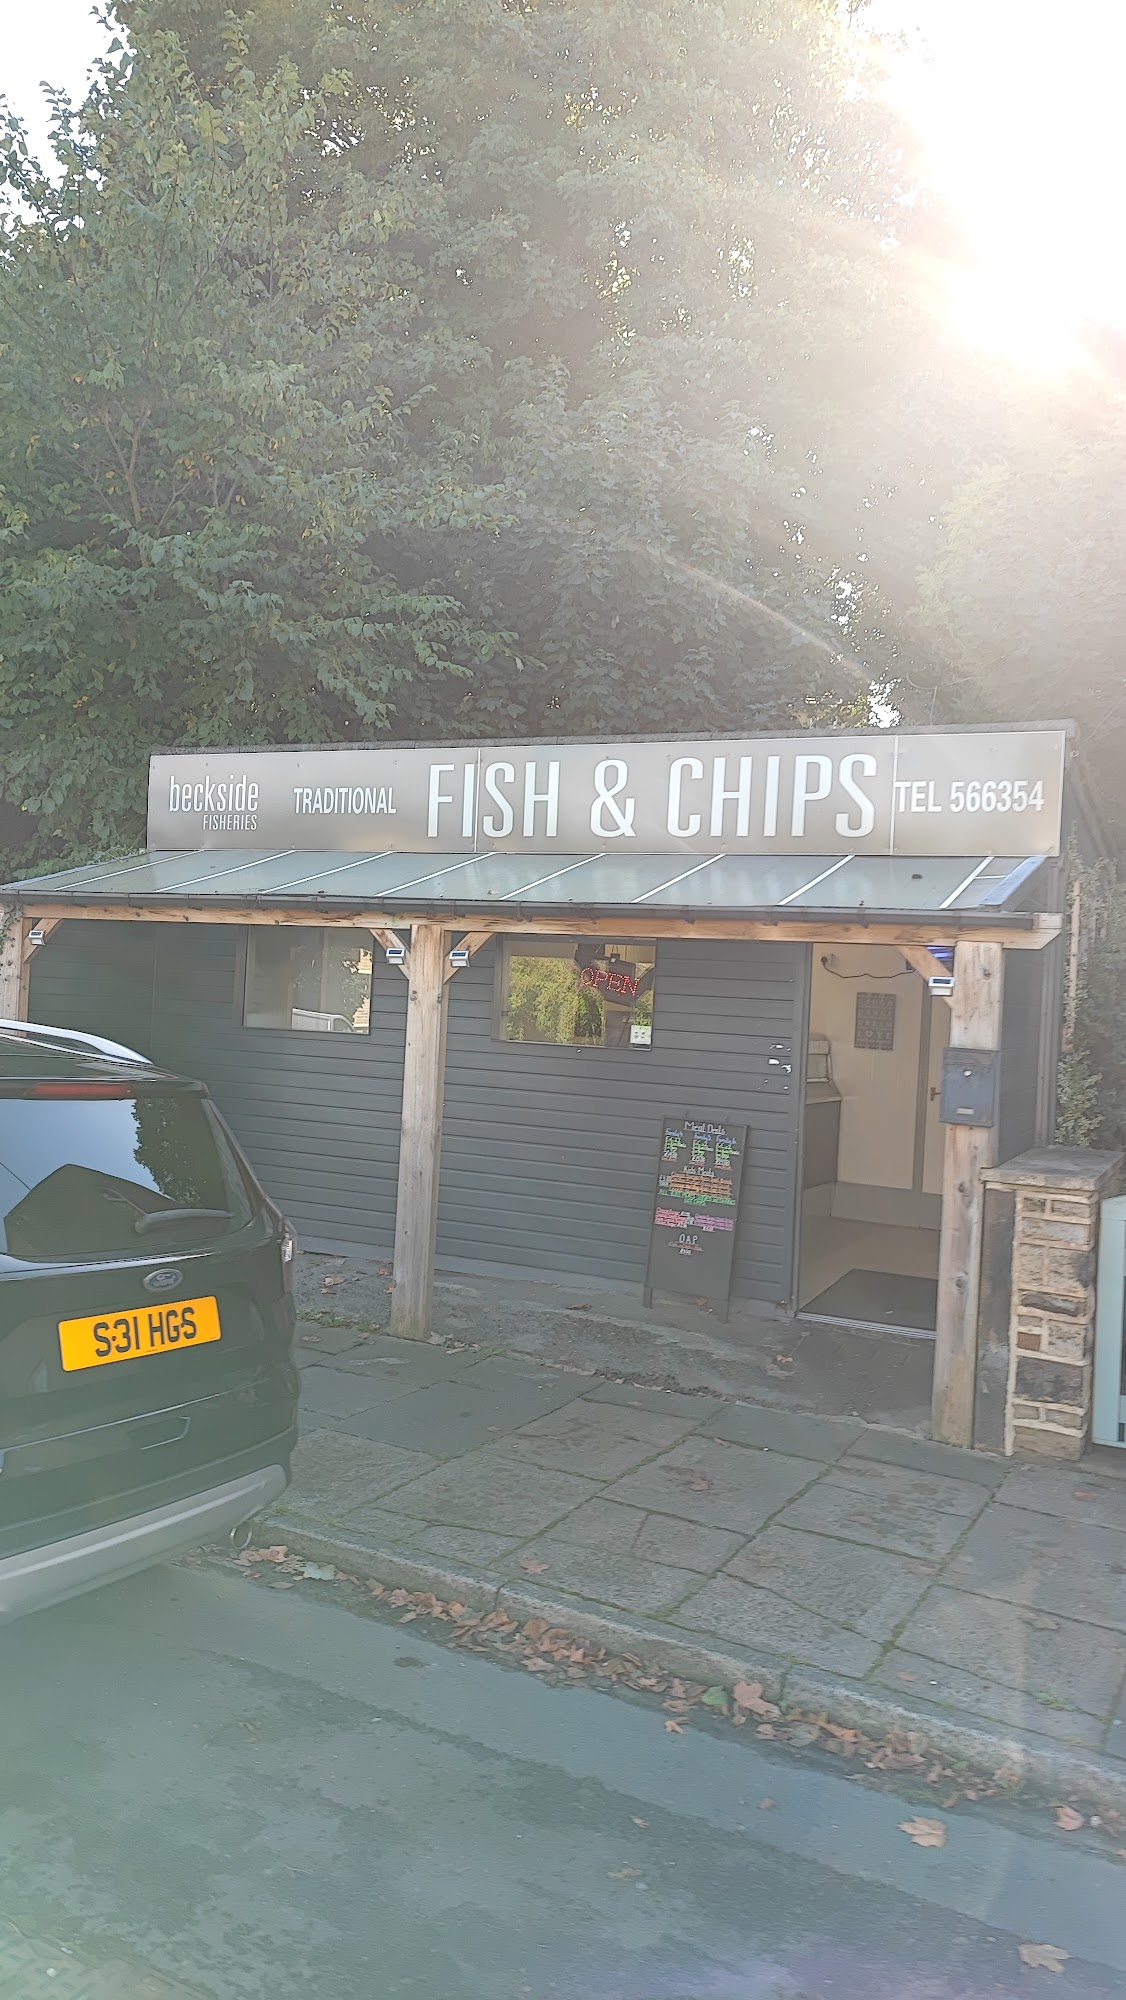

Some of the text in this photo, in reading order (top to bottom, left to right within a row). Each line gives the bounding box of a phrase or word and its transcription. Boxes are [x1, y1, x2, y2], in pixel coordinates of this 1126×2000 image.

[168, 775, 260, 812] beckside
[294, 787, 397, 814] TRADITIONAL
[427, 753, 877, 838] FISH & CHIPS
[895, 780, 1045, 814] TEL 566354
[202, 814, 258, 830] FISHERIES
[580, 967, 640, 997] OPEN
[684, 1121, 706, 1133] Meal
[679, 1233, 698, 1246] OAP
[93, 1306, 197, 1357] S31 HGS
